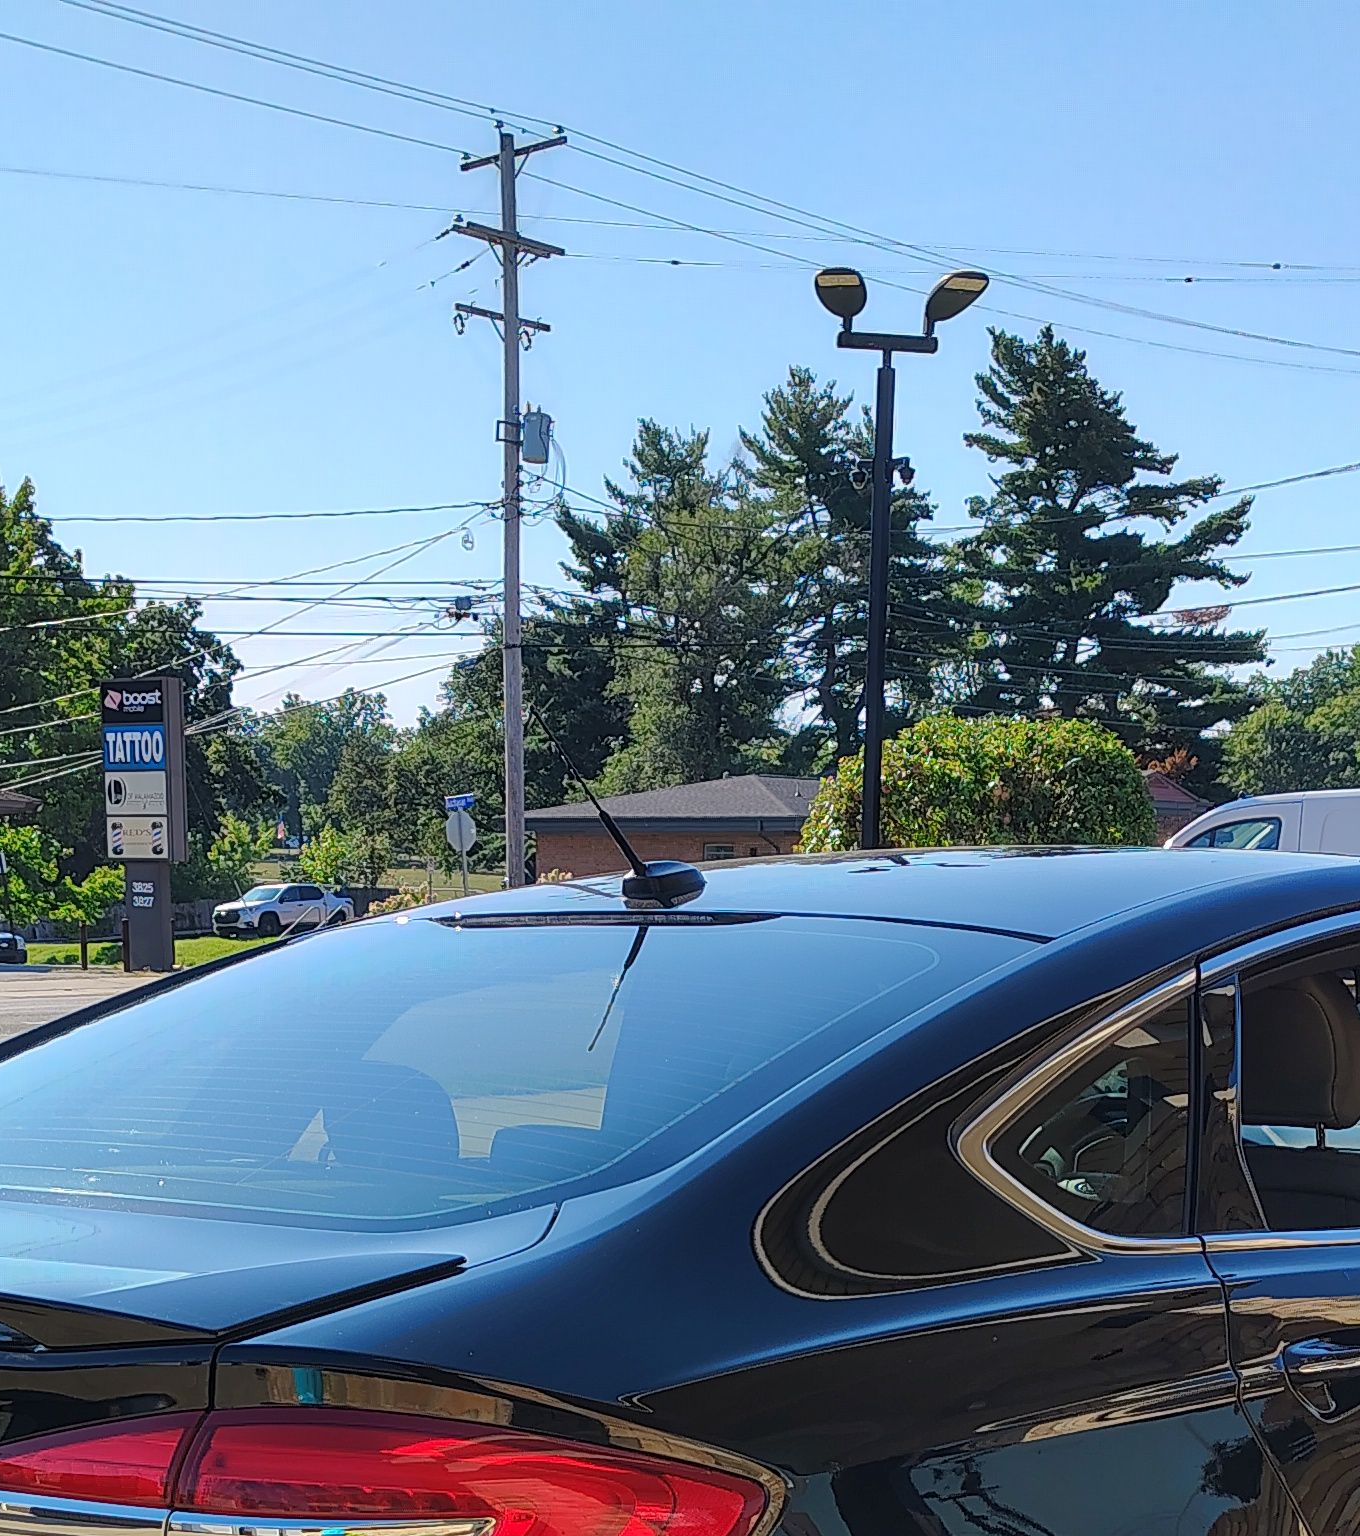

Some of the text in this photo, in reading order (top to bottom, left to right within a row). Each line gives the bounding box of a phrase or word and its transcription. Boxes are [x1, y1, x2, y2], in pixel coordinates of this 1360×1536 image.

[123, 689, 161, 705] boost
[106, 731, 163, 763] TATTOO
[132, 881, 154, 893] 3825
[132, 895, 155, 907] 3827
